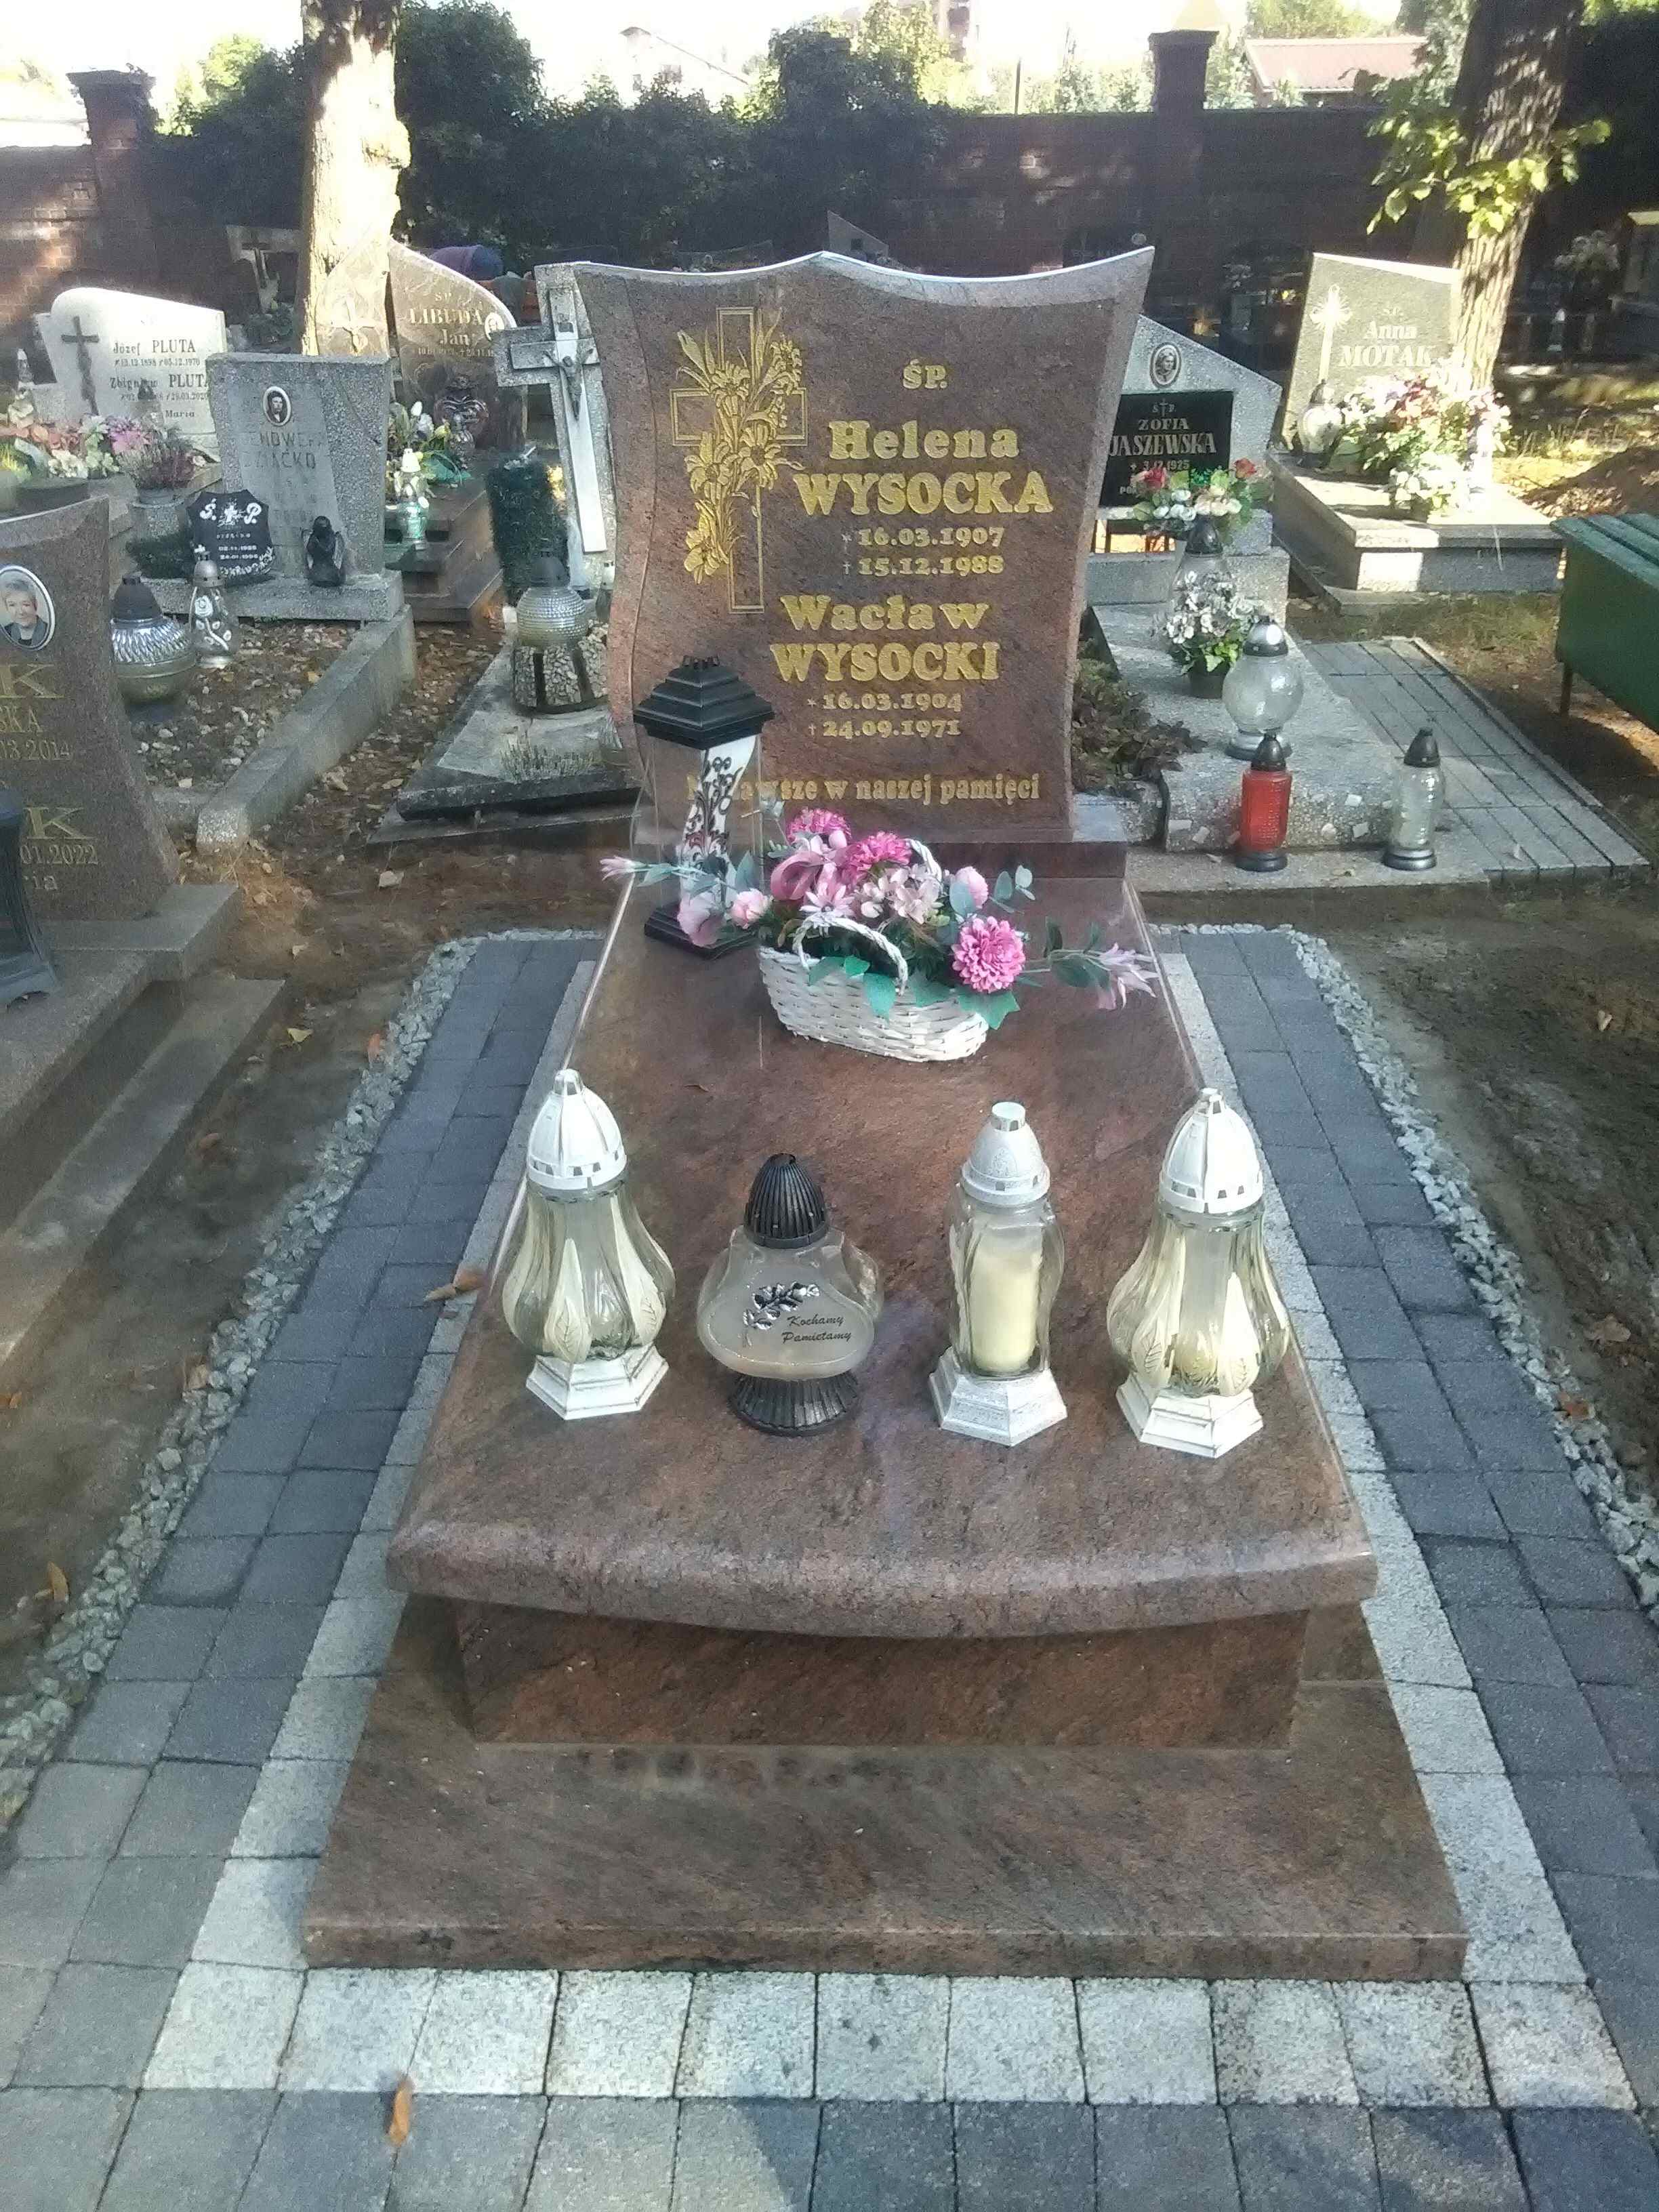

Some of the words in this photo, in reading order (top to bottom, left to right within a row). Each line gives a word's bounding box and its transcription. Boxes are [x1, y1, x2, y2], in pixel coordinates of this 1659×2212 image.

[439, 329, 470, 346] Jan
[1363, 320, 1417, 339] Anna
[113, 341, 140, 356] Józef
[151, 339, 197, 353] PLUTA
[1338, 344, 1437, 367] MOTAK
[902, 357, 947, 389] ŚP.
[165, 409, 195, 418] Maria
[1137, 418, 1189, 431] ZOFIA
[828, 419, 1019, 459] Helena
[1108, 432, 1217, 457] JASZEWSKA
[792, 471, 1054, 516] WYSOCKA
[858, 527, 1005, 548] 16.03.1907
[858, 555, 1005, 577] 15.12.1988
[779, 594, 990, 632] Wacław
[770, 642, 1000, 682] WYSOCKI
[822, 692, 963, 712] 16.03.1904
[822, 719, 962, 739] 24.09.1971
[823, 780, 848, 800] w
[856, 773, 932, 806] naszej
[939, 773, 1040, 806] pamięci
[787, 1313, 844, 1327] Kochamy
